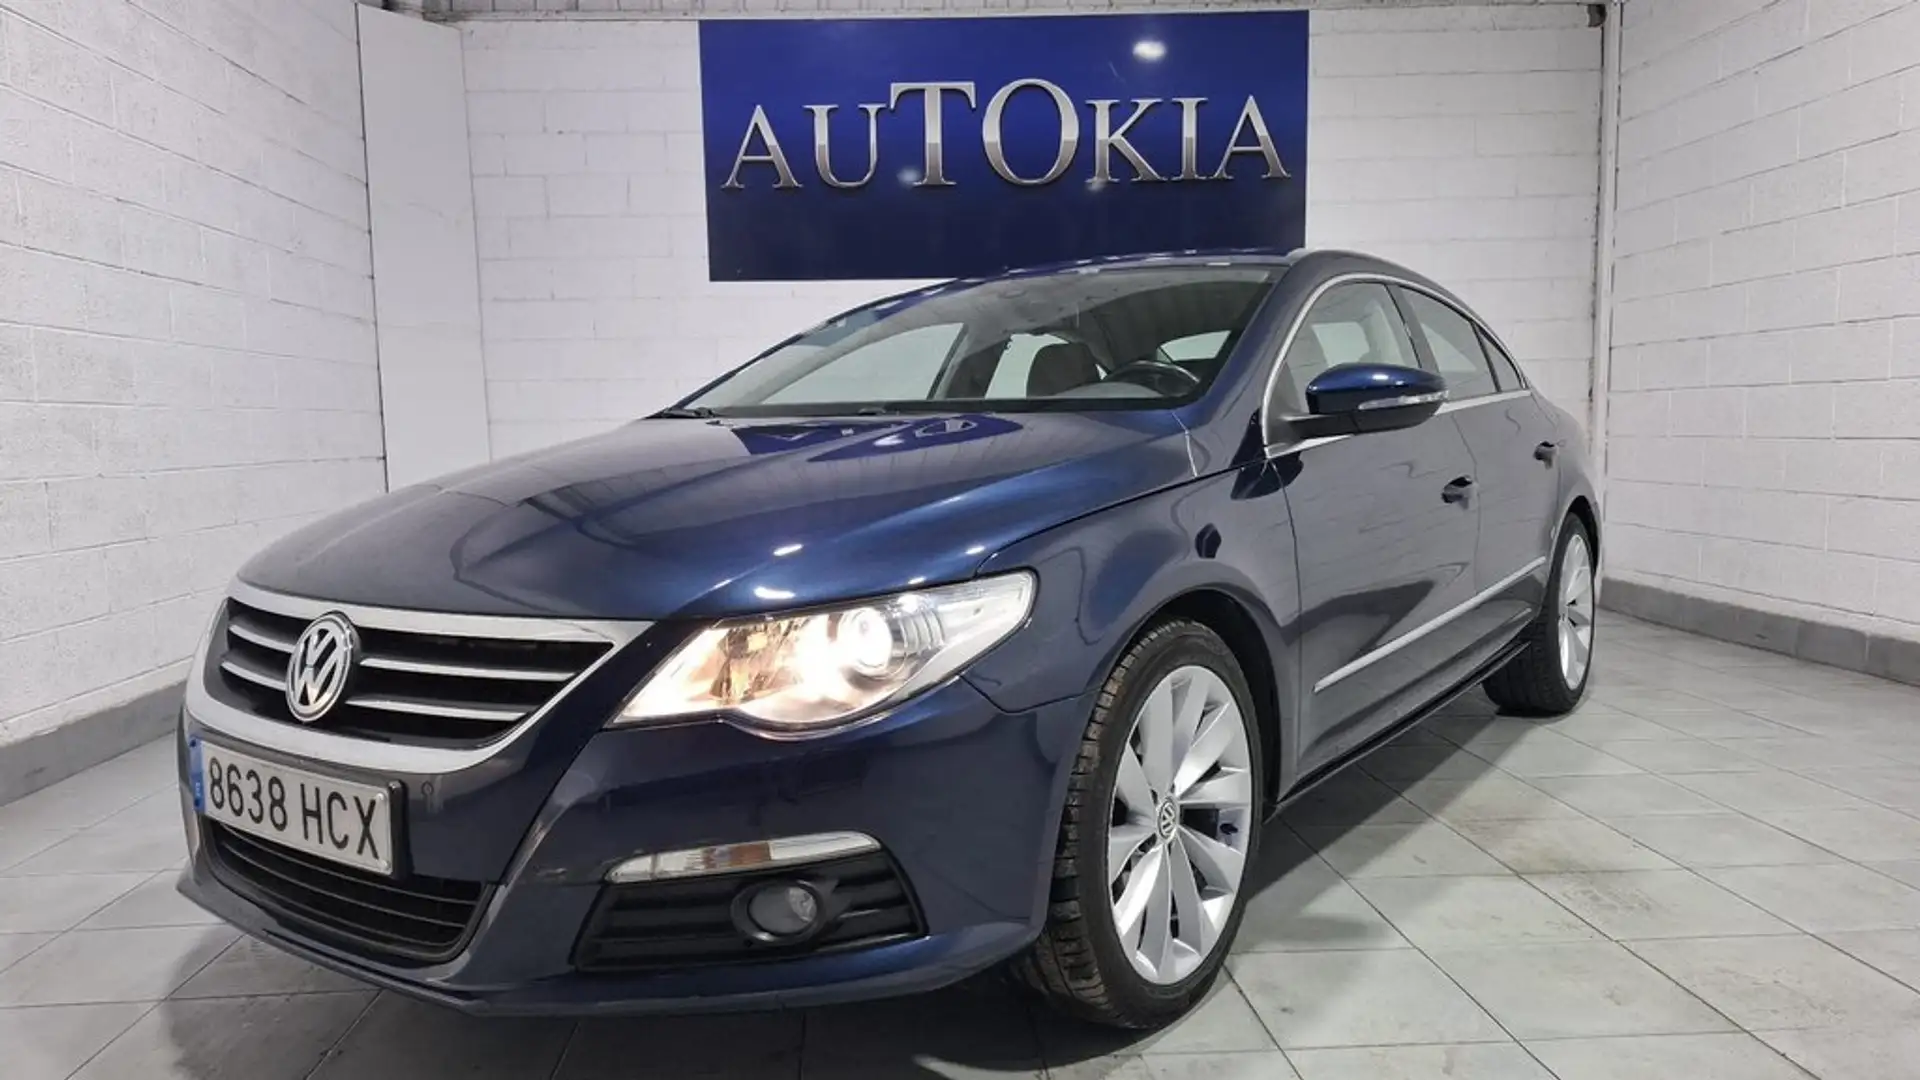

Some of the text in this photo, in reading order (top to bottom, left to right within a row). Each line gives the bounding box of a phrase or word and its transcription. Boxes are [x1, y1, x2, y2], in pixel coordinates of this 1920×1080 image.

[720, 78, 1292, 189] AUTOKIA
[291, 620, 345, 714] VW
[209, 757, 380, 861] 8638 HCX
